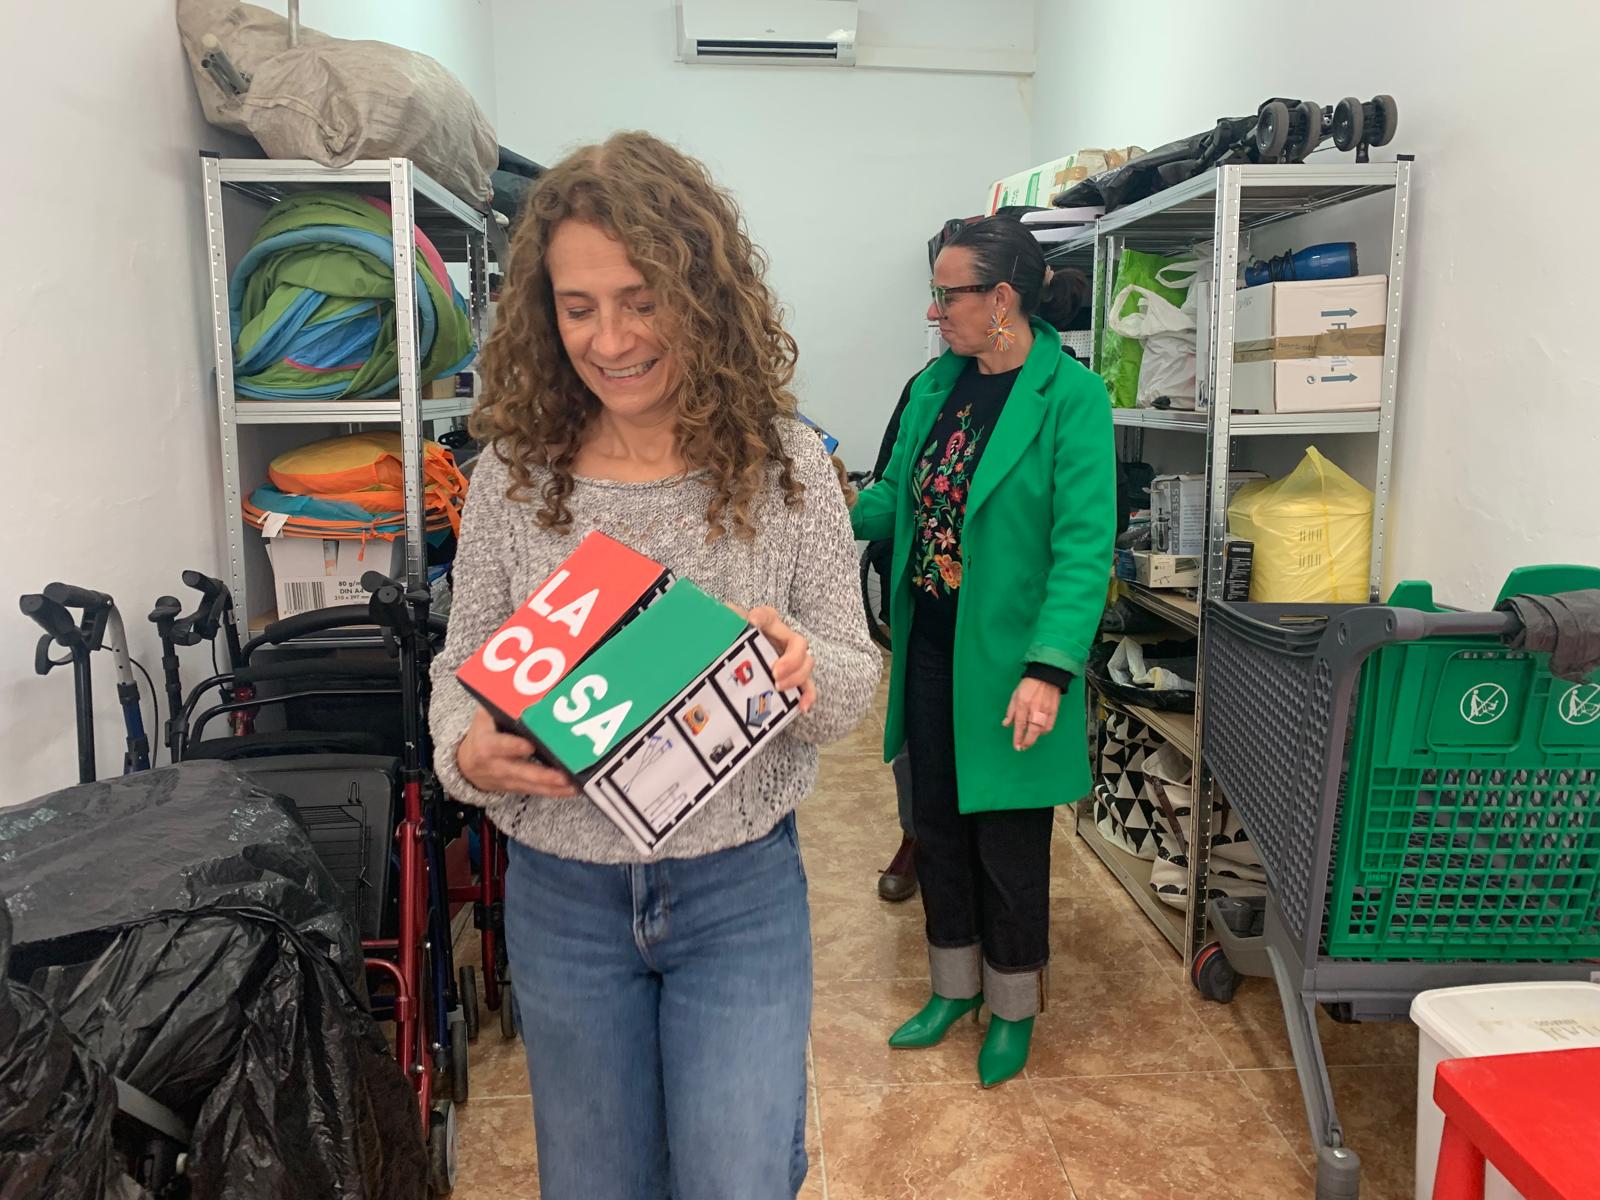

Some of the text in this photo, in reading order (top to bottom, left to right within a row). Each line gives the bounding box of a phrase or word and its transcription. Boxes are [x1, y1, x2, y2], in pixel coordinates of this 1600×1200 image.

[528, 569, 600, 638] LA
[482, 626, 566, 696] CO
[552, 674, 633, 756] SA
